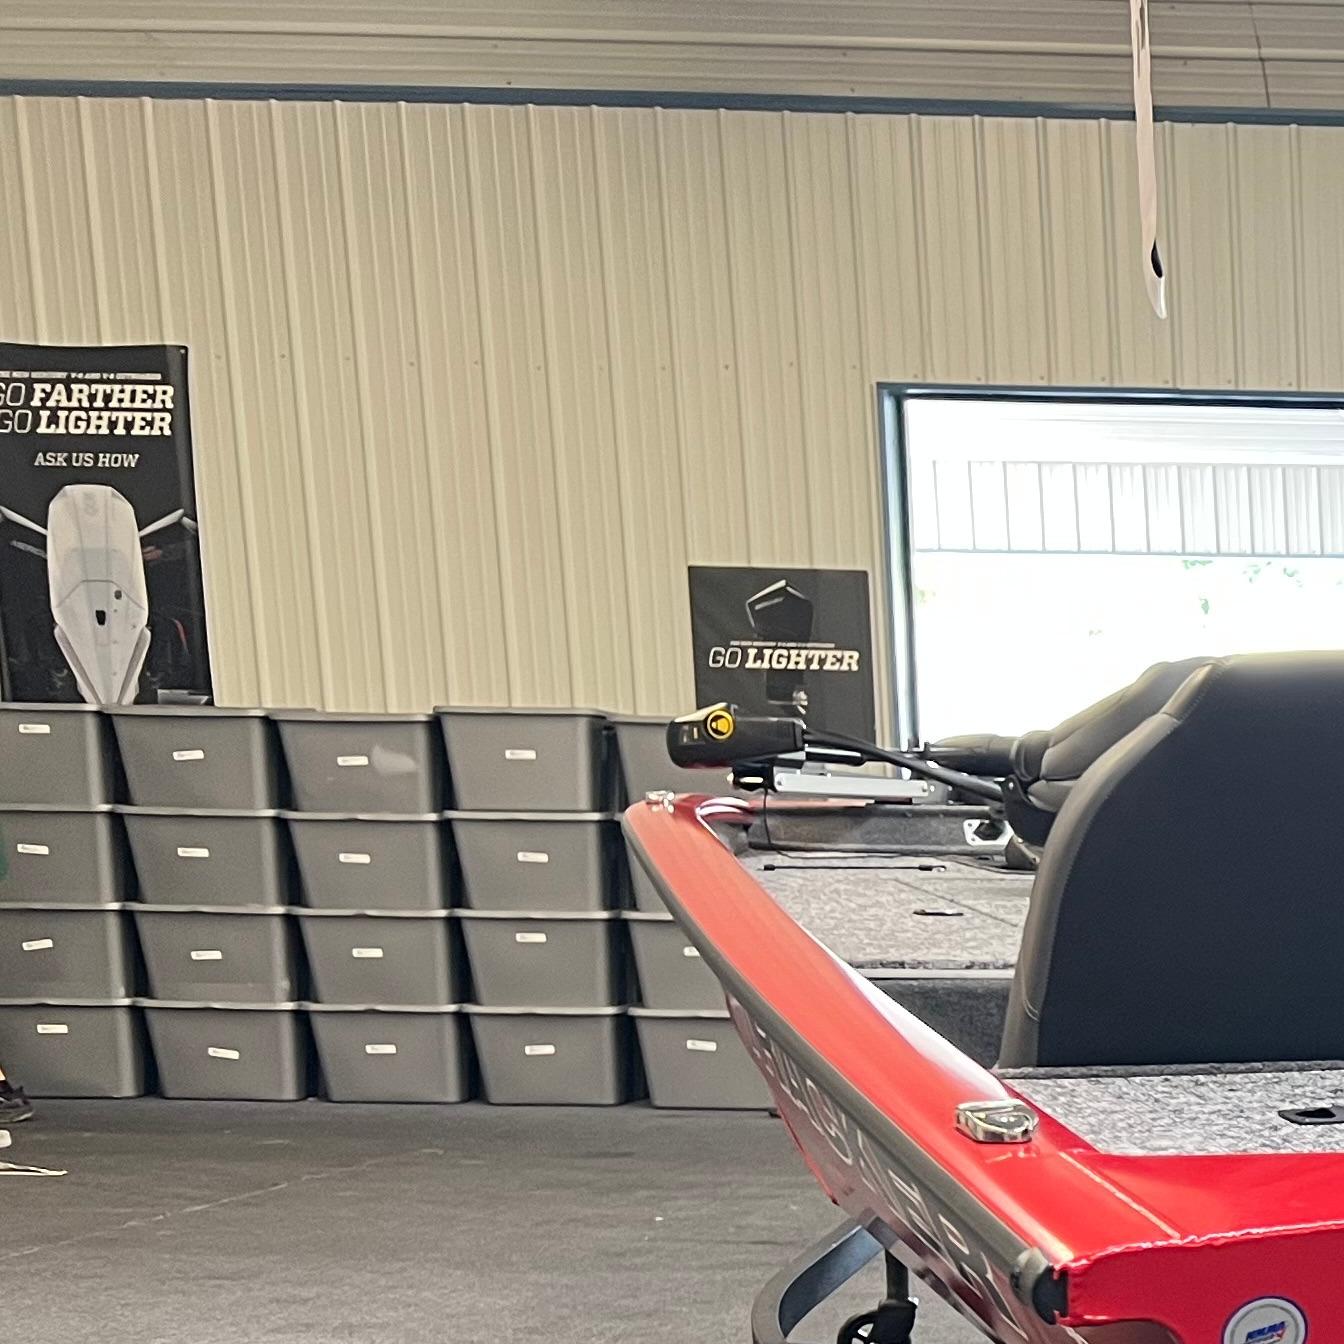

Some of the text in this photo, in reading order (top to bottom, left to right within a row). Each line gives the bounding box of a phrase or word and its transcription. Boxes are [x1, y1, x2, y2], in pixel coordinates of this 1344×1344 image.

[30, 383, 175, 410] FARTHER
[36, 410, 173, 437] LIGHTER
[34, 452, 140, 468] ASK US HOW
[708, 646, 860, 672] GO LIGHTER
